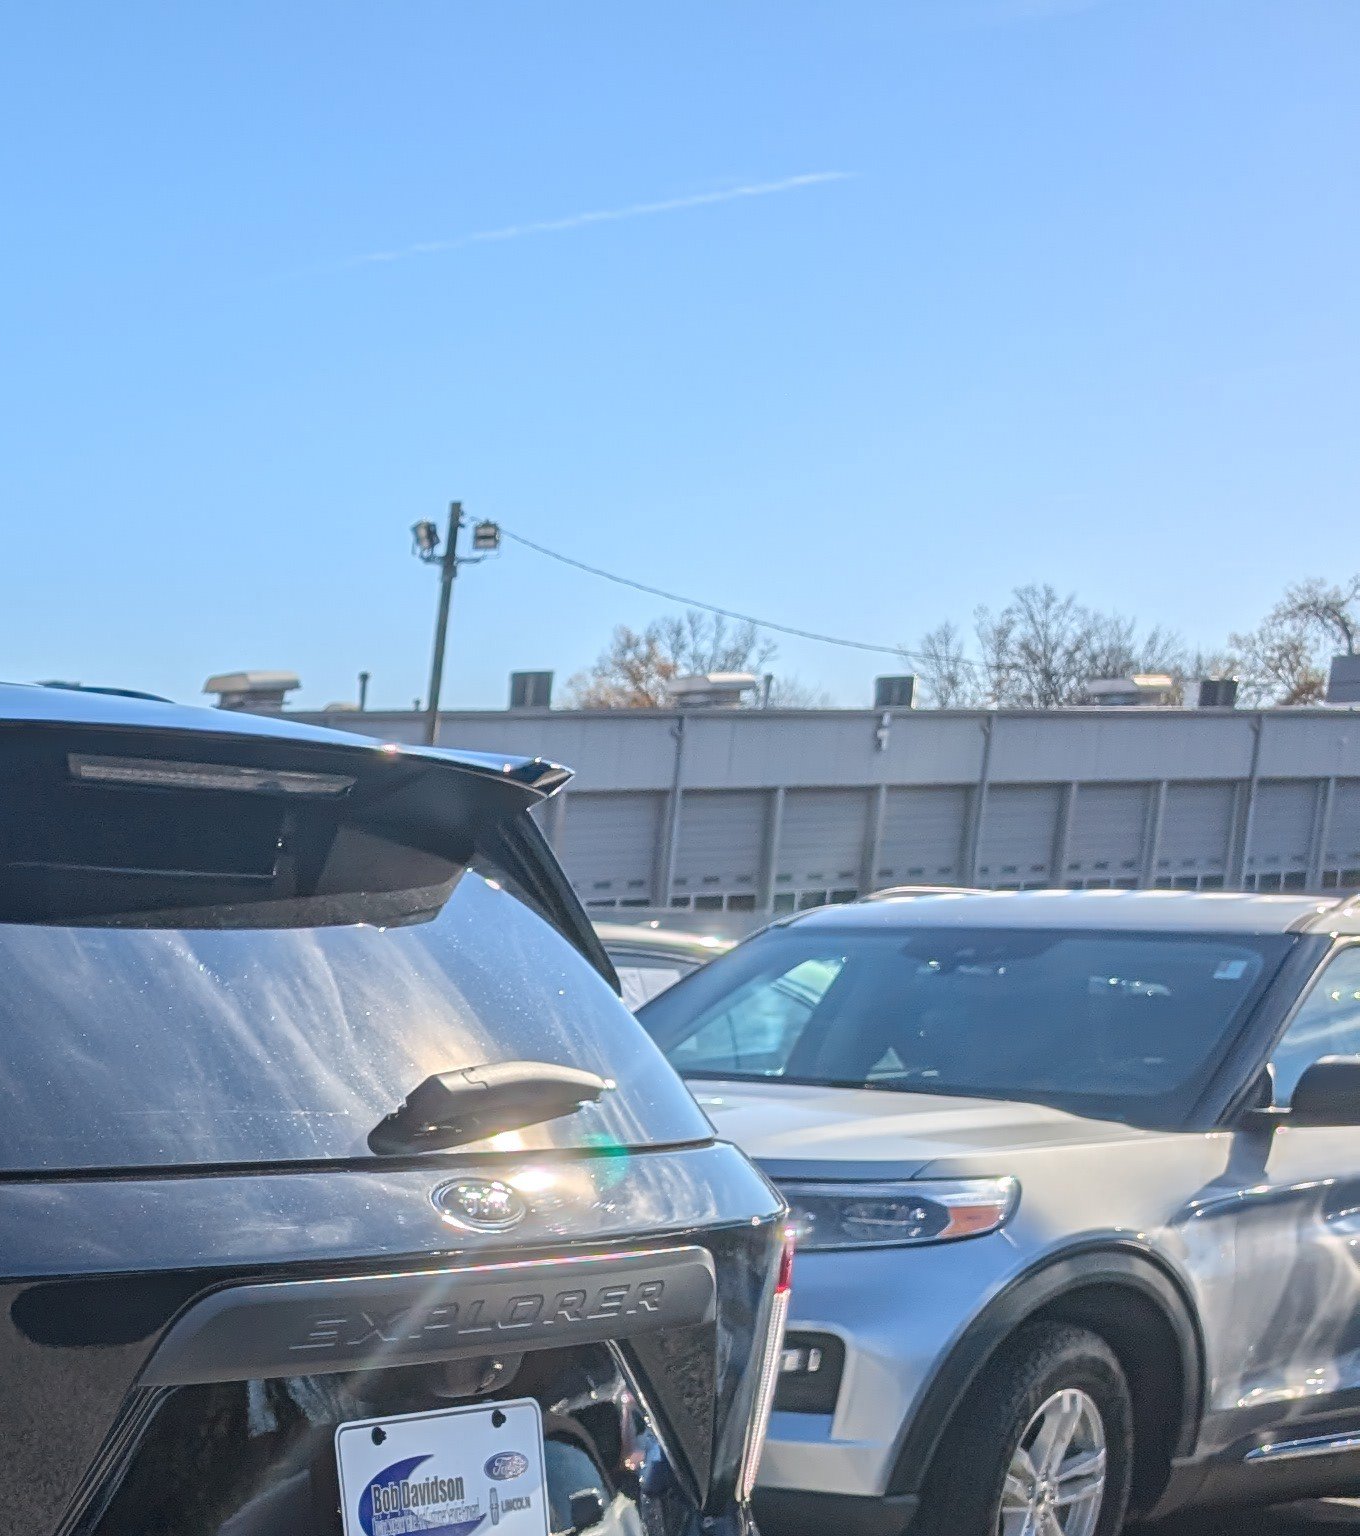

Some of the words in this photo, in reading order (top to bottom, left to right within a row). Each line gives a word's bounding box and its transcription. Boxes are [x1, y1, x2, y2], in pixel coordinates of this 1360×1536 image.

[289, 1279, 665, 1350] EXPLORER
[371, 1482, 400, 1514] Bob
[400, 1475, 465, 1508] Davidson
